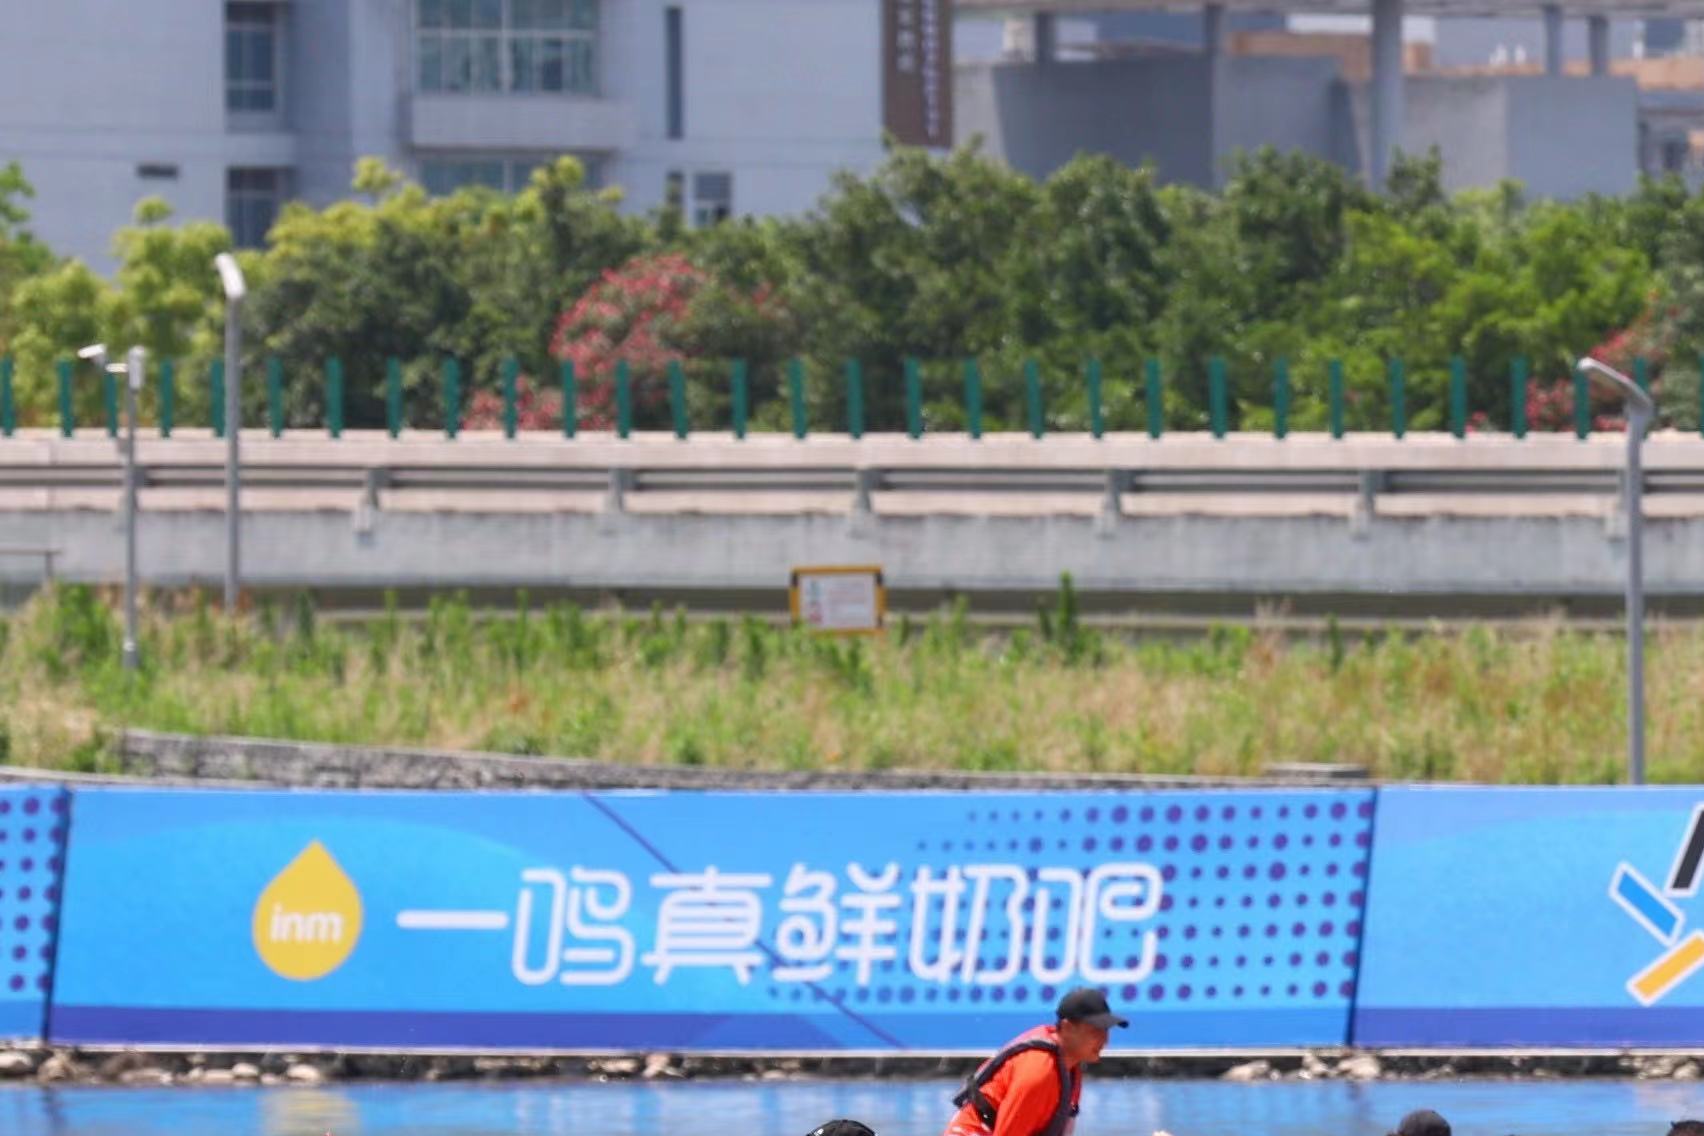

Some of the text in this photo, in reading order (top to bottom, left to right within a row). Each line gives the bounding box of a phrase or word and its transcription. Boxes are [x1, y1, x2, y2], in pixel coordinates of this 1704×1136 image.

[269, 903, 345, 942] inm
[396, 861, 1165, 985] 一鸣真鲜奶吧
